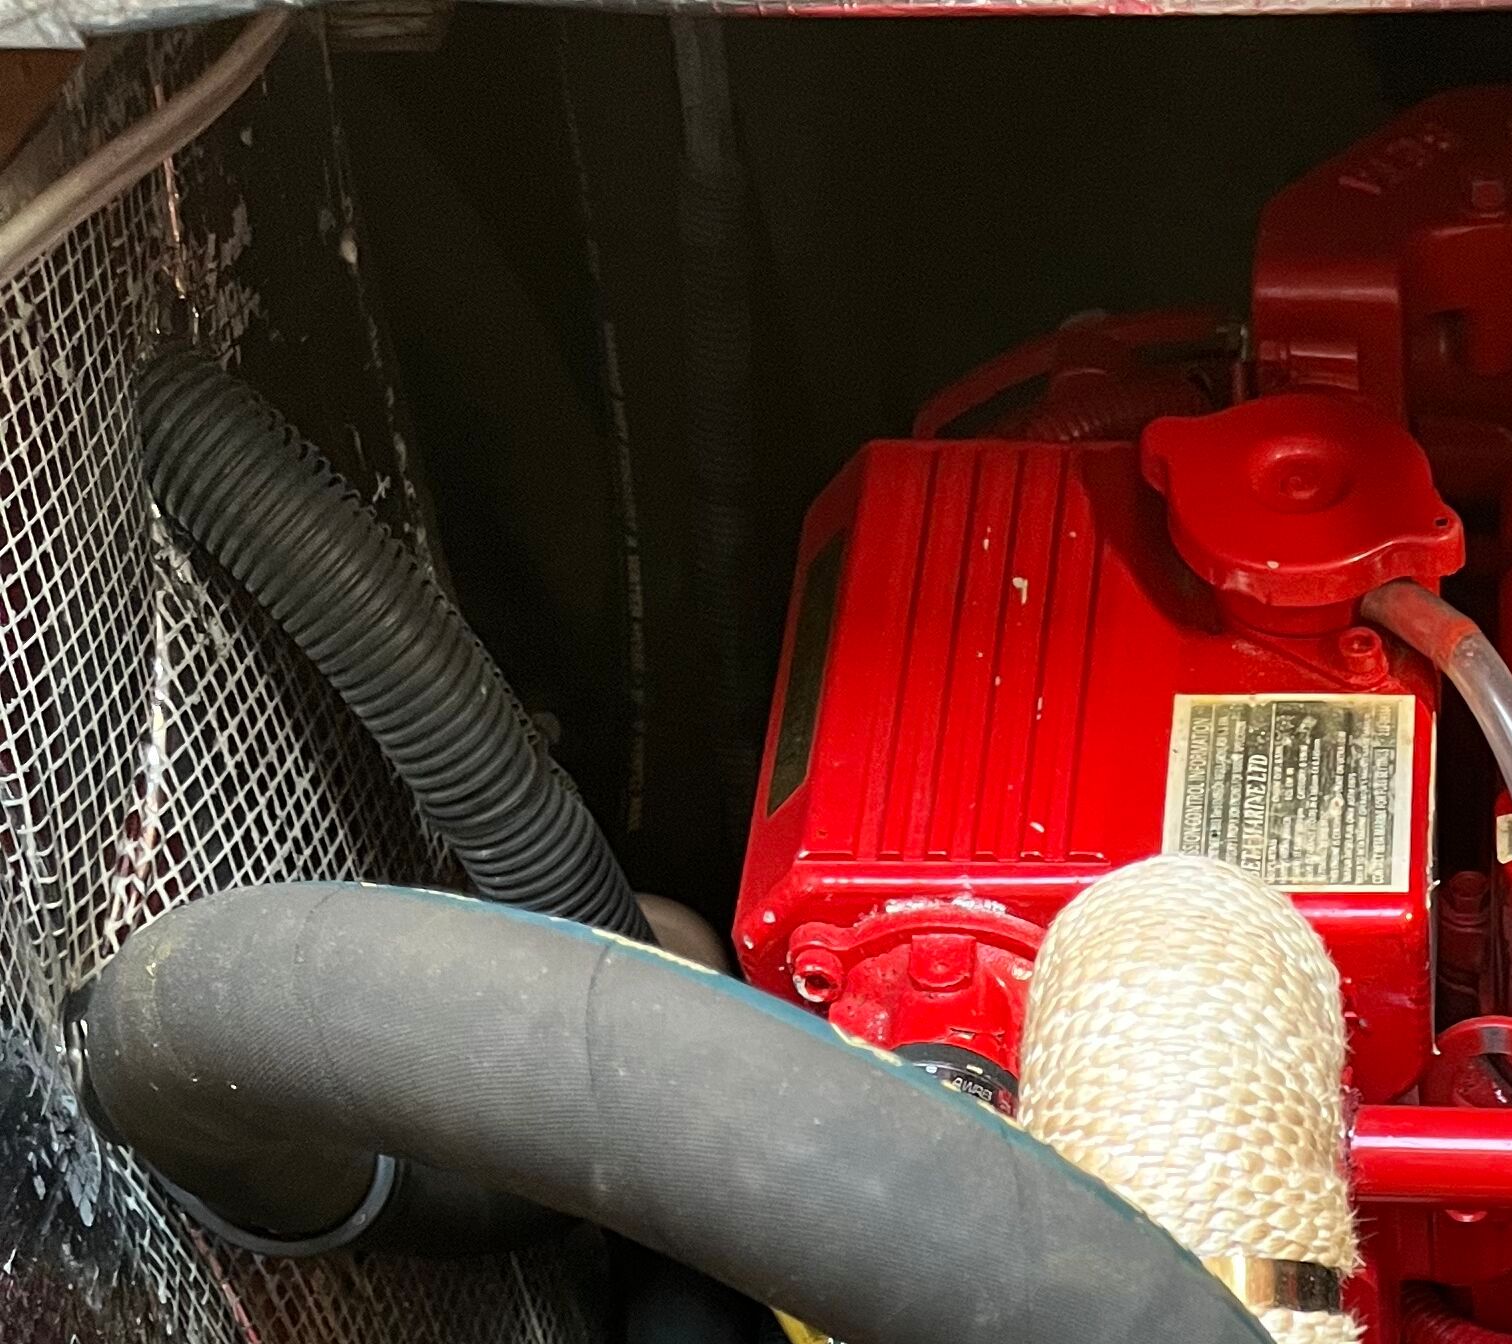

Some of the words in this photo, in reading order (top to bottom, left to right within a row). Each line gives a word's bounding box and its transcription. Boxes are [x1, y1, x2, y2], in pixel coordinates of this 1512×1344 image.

[1187, 717, 1209, 781] INFORMATION
[1246, 753, 1268, 782] LTD
[1180, 826, 1200, 858] SSION
